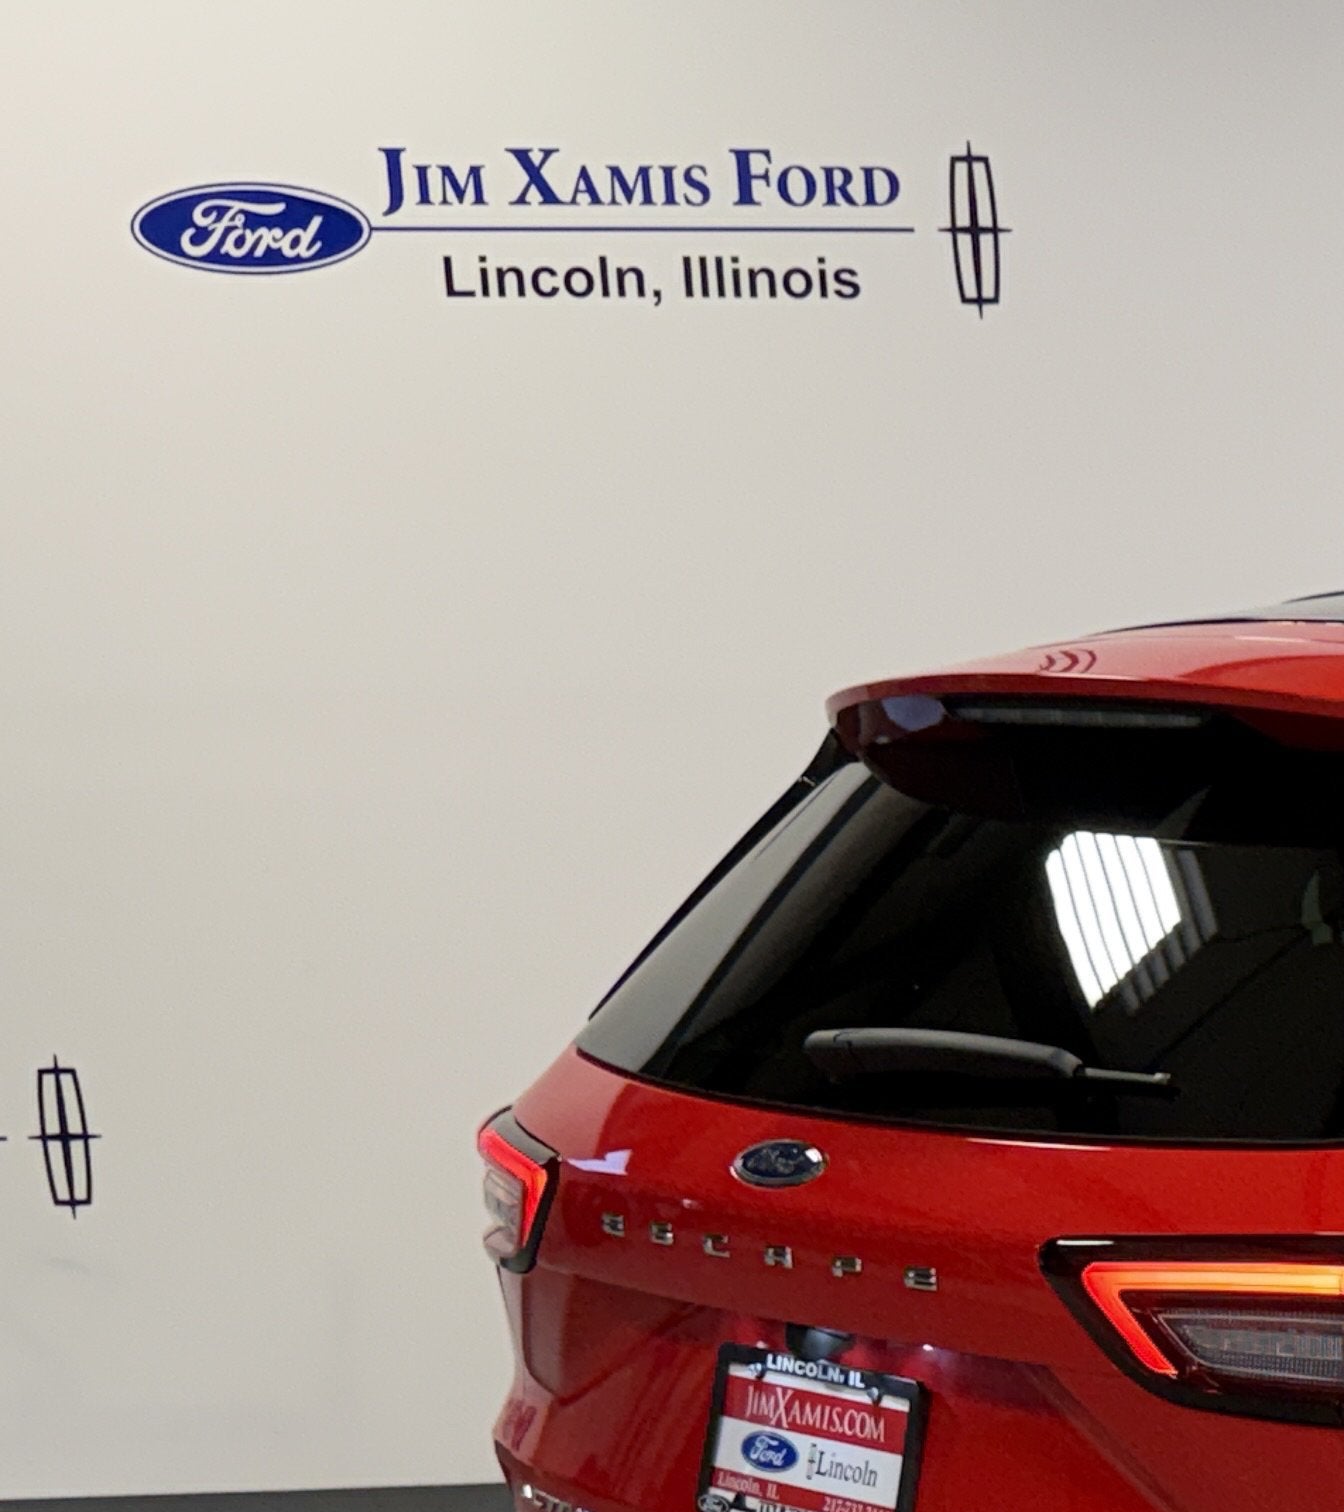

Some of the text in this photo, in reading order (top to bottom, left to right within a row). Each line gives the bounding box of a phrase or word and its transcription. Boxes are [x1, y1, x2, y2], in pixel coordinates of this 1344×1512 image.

[378, 147, 900, 217] JIM XAMIS FORD
[179, 197, 324, 260] Ford
[443, 255, 862, 307] Lincoln, Illinois
[601, 1212, 938, 1292] ESCAPE
[766, 1353, 866, 1389] LINCOLN, IL
[744, 1385, 886, 1443] JIMXAMIS.COM
[751, 1435, 785, 1467] Ford
[815, 1450, 879, 1488] Lincoln
